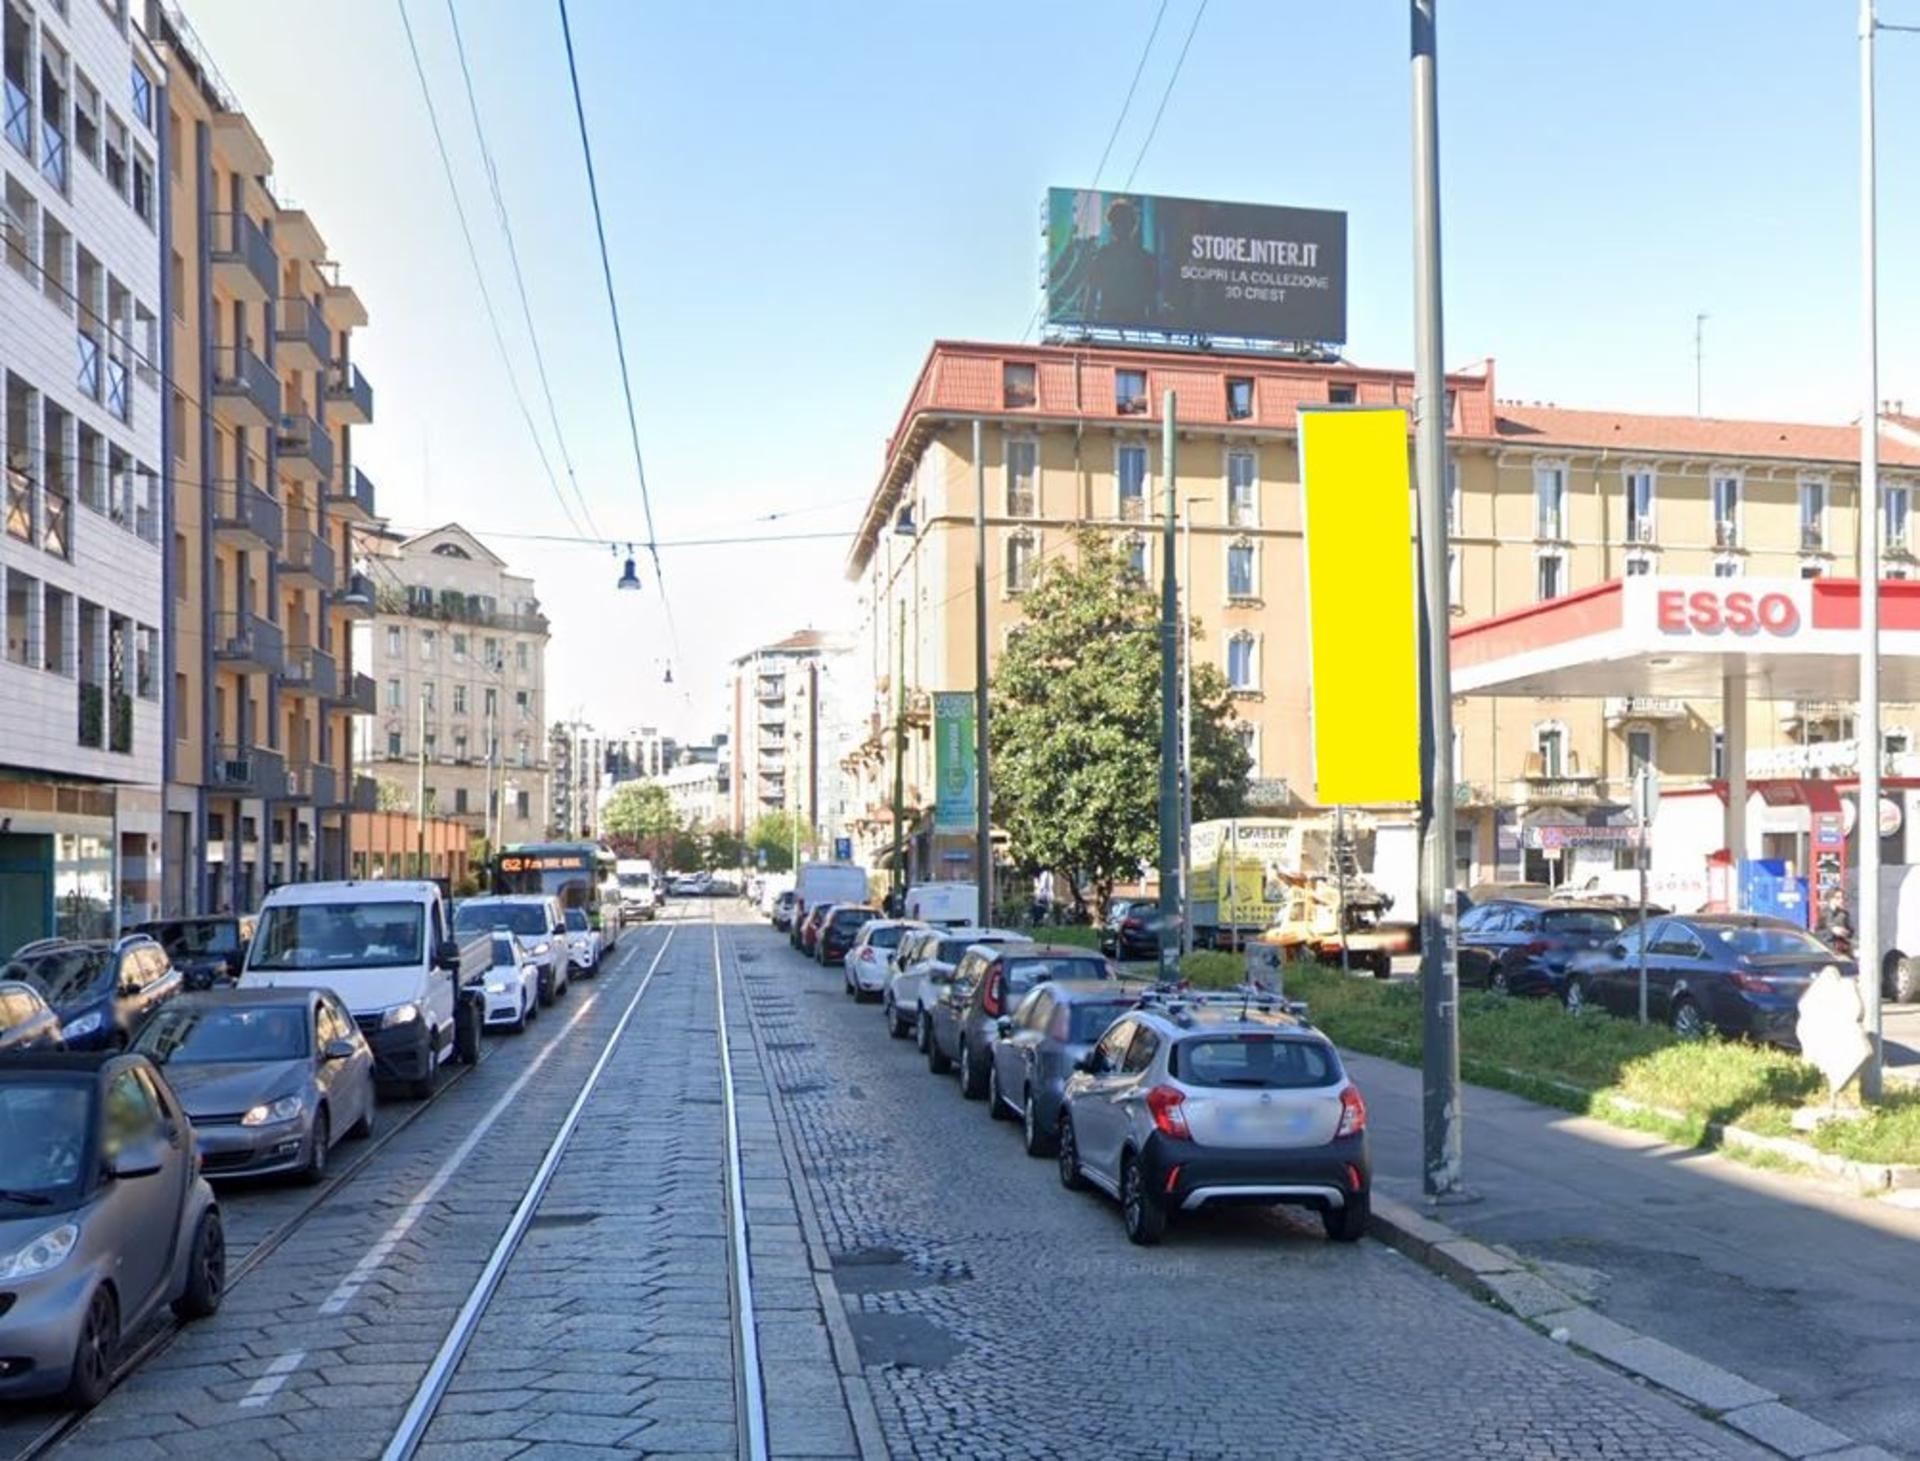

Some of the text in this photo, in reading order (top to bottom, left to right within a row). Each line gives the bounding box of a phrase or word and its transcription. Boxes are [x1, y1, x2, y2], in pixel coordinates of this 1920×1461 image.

[1191, 234, 1319, 268] STORE.INTER.IT
[1180, 265, 1329, 290] SCOPRI LA COLLEZIONE
[1245, 287, 1286, 302] CREST
[1656, 590, 1801, 635] ESSO
